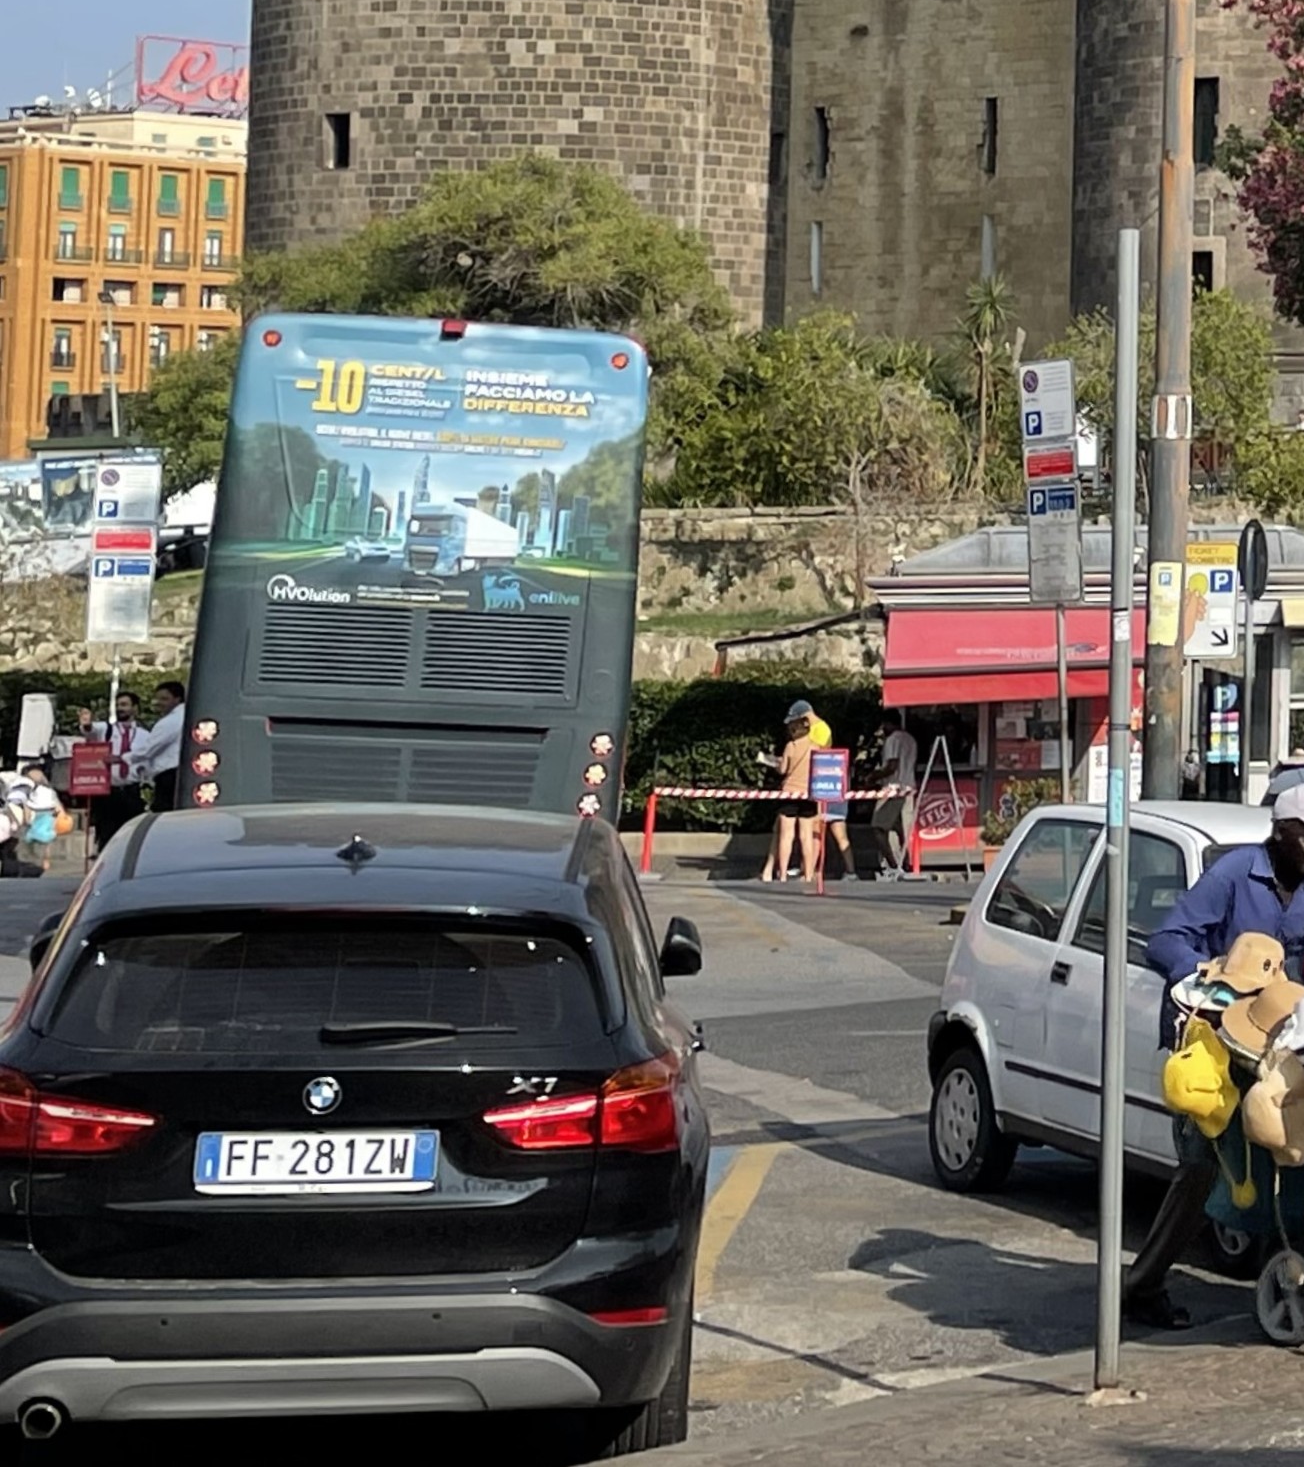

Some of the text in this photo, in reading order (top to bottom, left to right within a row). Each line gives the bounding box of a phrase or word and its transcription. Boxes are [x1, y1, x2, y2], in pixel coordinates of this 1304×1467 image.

[371, 364, 446, 381] CENT/L
[466, 370, 548, 386] INSIEME
[296, 359, 365, 413] -10
[464, 384, 595, 404] FACCIAMO LA
[463, 398, 588, 416] DIFFERENZA
[1214, 572, 1229, 591] P
[529, 590, 580, 605] enilive
[506, 1076, 558, 1102] X1
[225, 1139, 274, 1177] FF
[289, 1138, 410, 1176] 281ZW
